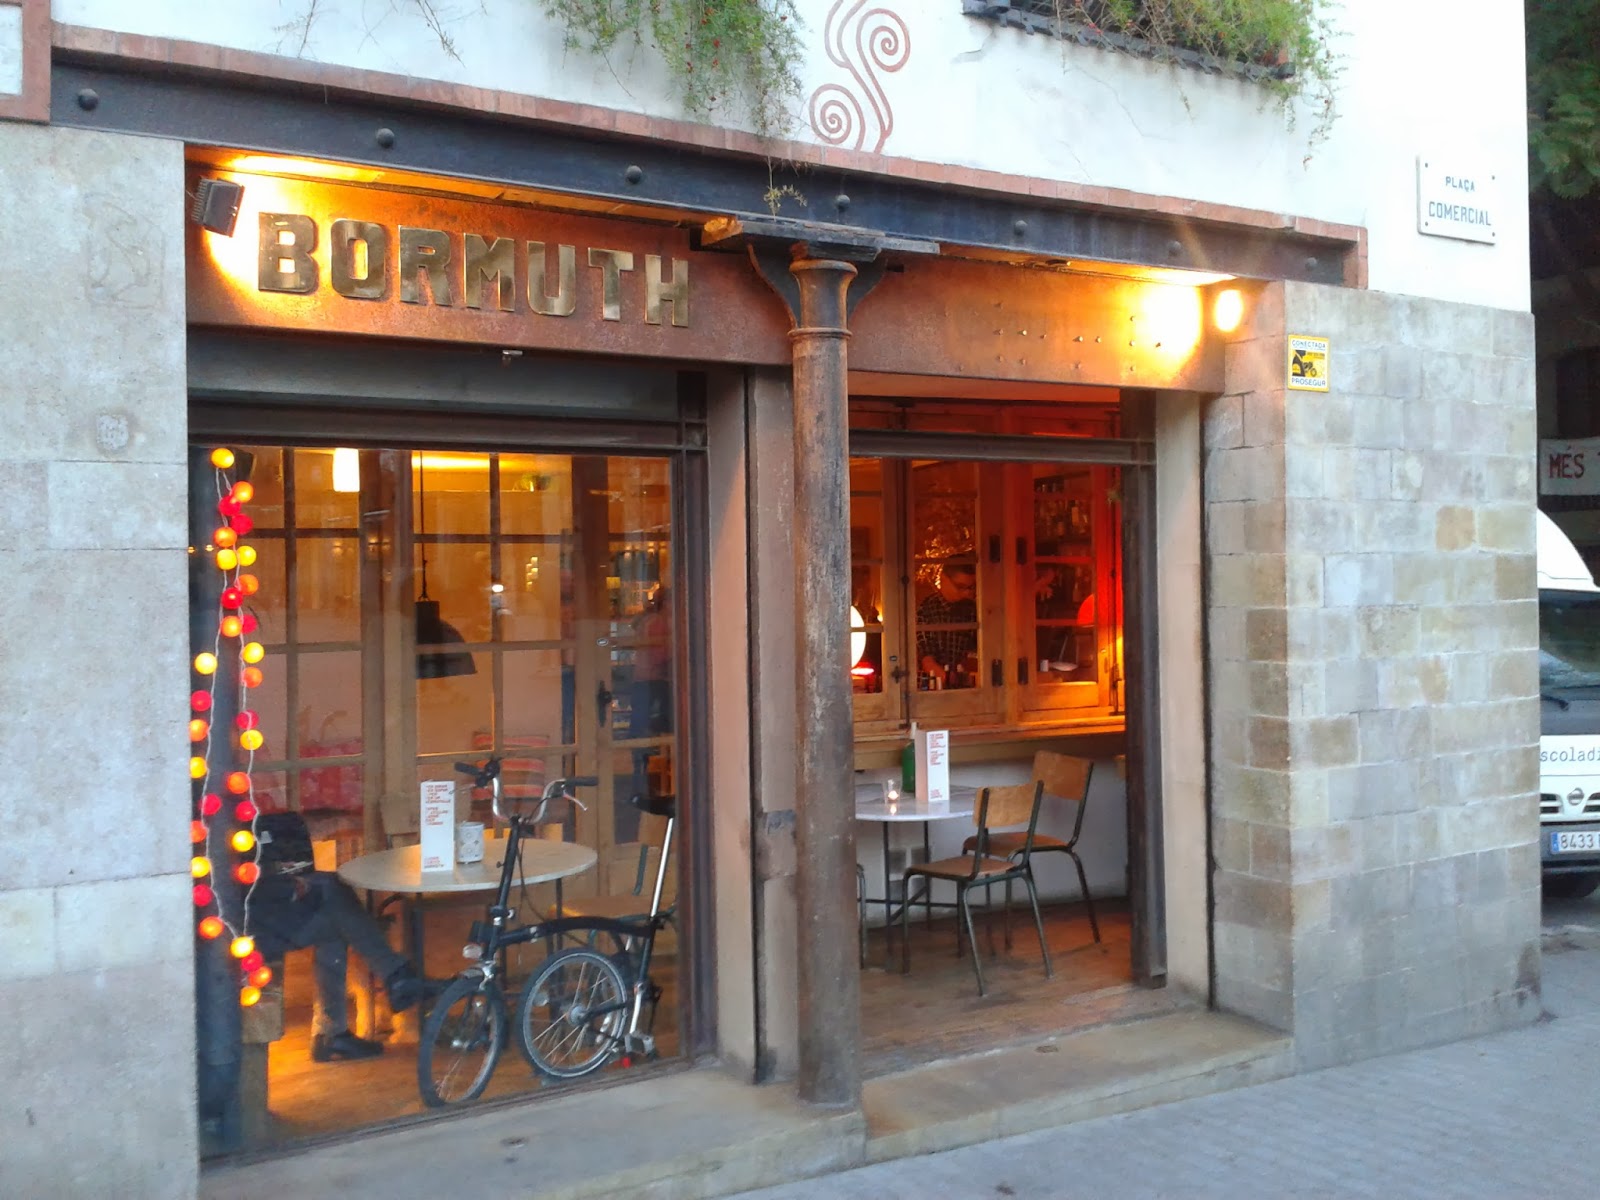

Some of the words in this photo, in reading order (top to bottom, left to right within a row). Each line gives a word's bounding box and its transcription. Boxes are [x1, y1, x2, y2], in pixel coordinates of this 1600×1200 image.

[1445, 175, 1475, 192] PLAÇA
[1428, 200, 1491, 226] COMERCIAL
[257, 211, 689, 327] BORMUTH
[1291, 339, 1326, 349] CONECTADA
[1291, 377, 1326, 387] PROSEGUR
